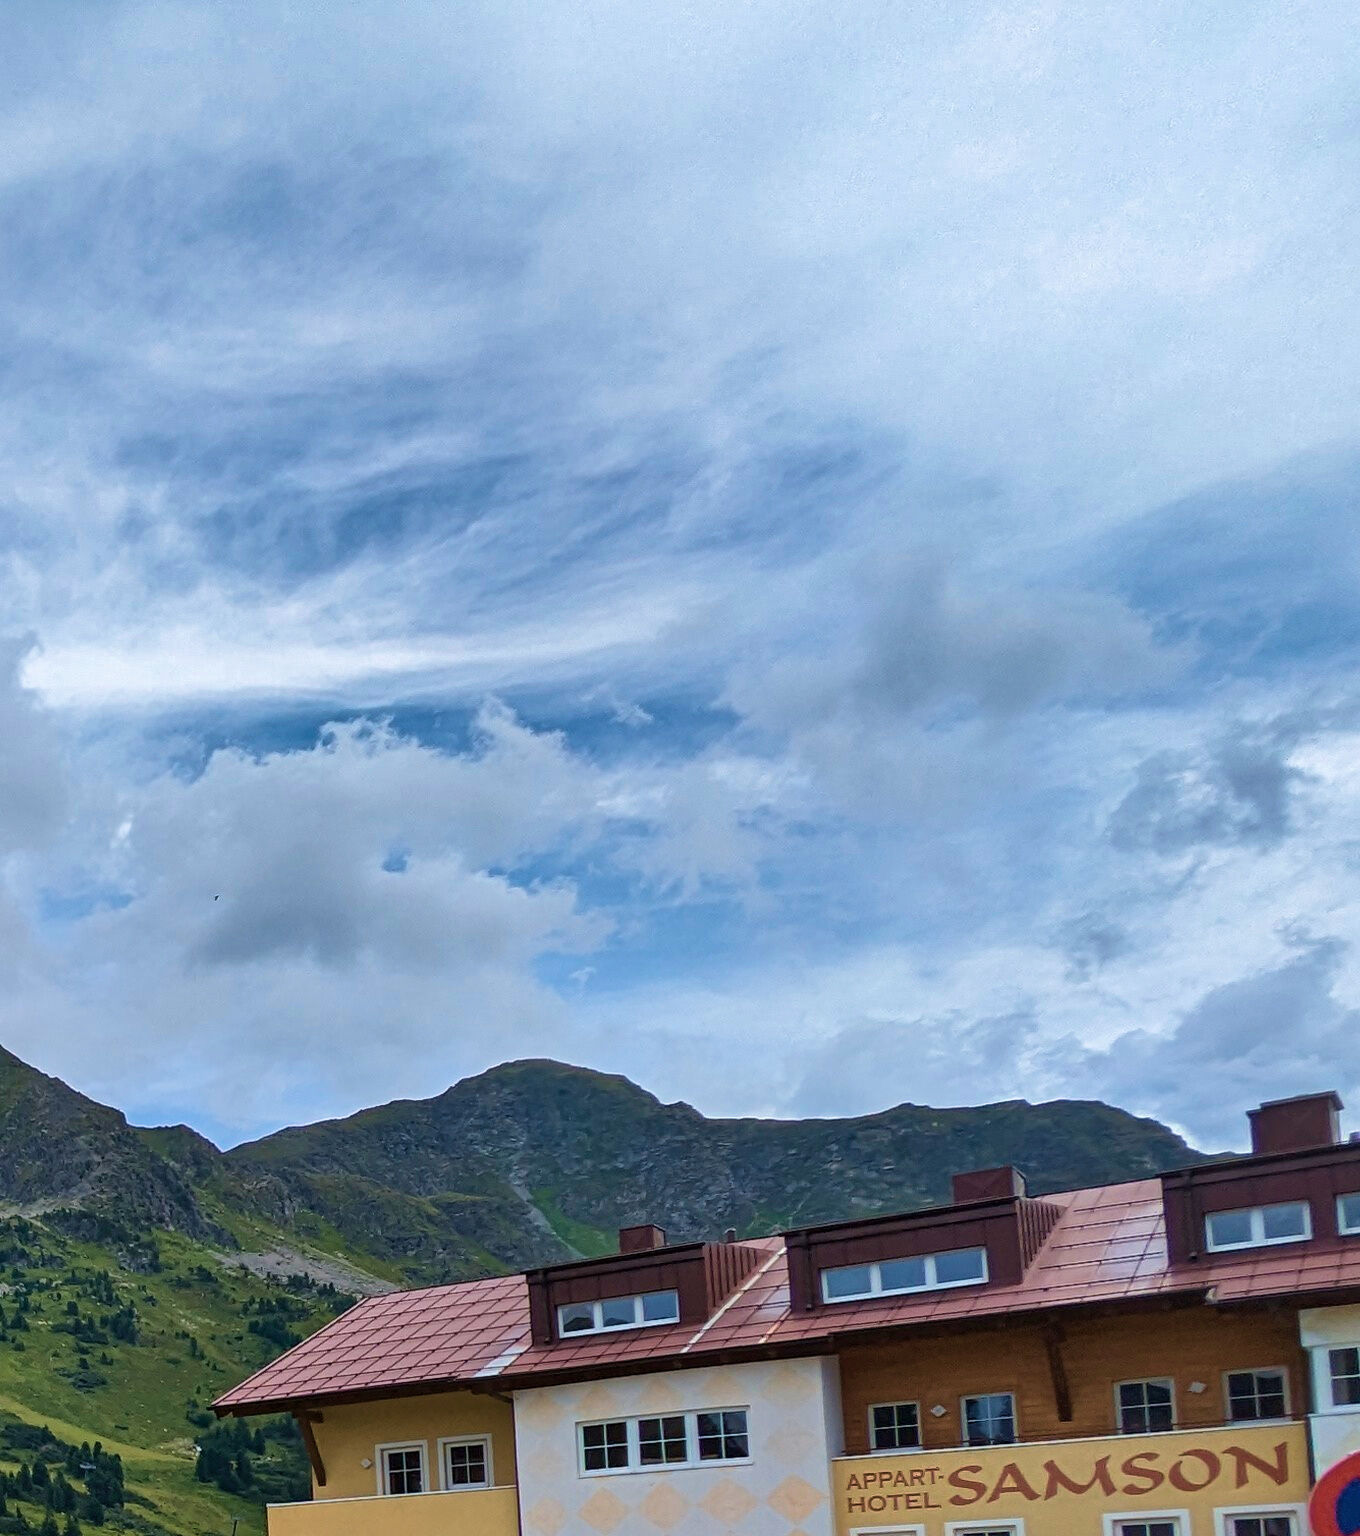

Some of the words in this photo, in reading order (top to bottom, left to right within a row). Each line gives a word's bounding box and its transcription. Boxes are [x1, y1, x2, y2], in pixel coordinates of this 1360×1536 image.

[846, 1466, 944, 1491] APPART-
[948, 1441, 1290, 1506] SAMSON
[846, 1492, 942, 1514] HOTEL
